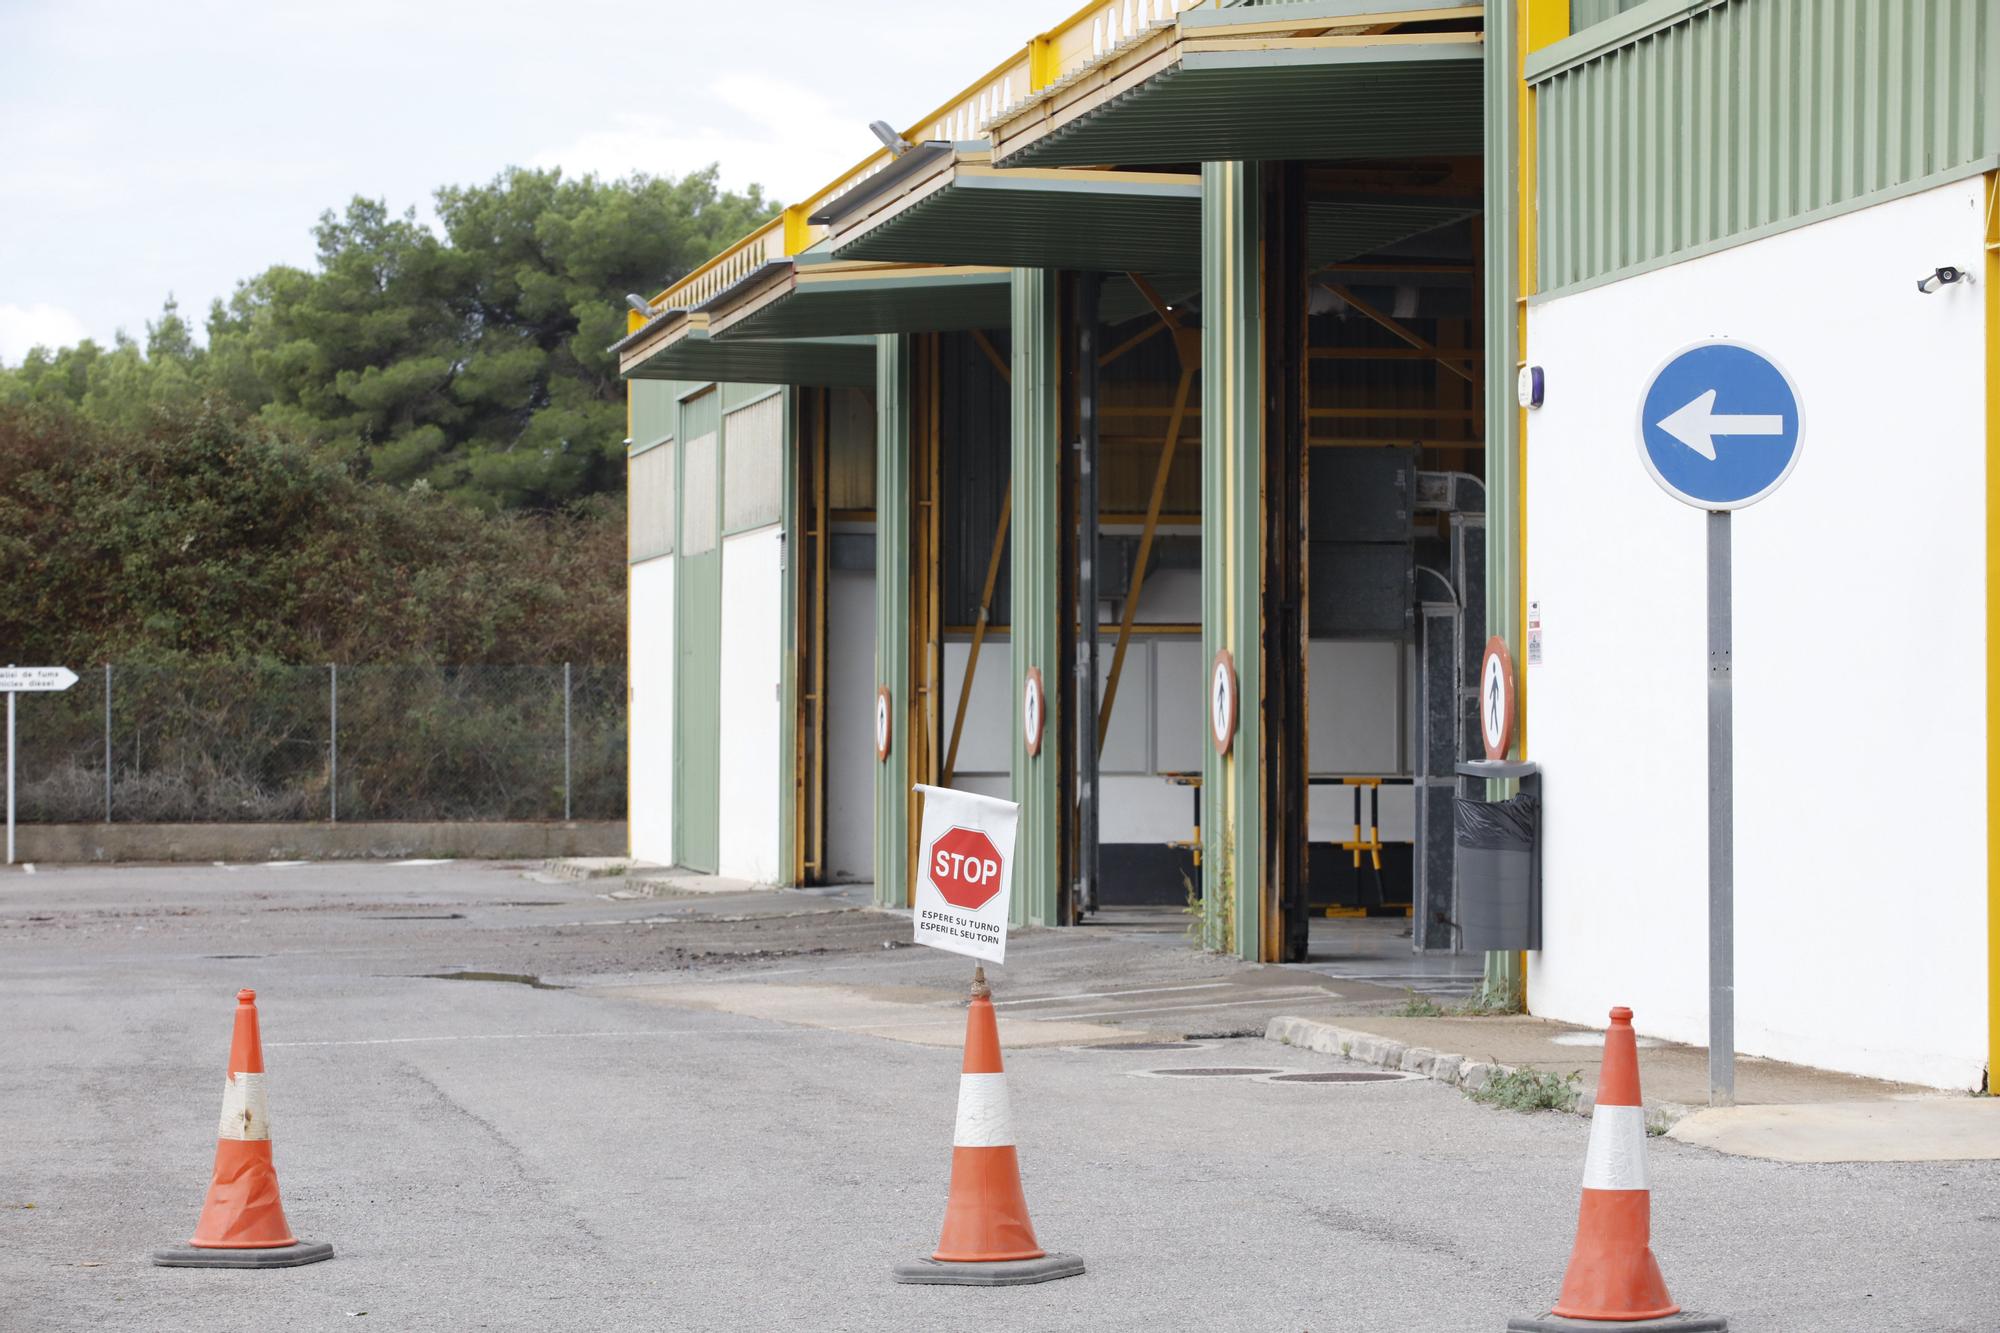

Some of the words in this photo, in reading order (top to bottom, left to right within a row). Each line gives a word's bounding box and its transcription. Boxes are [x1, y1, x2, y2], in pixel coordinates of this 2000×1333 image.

[935, 850, 998, 885] STOP
[921, 922, 948, 933] ESPERI
[950, 928, 958, 936] EL
[960, 929, 975, 940] SEU
[976, 933, 999, 945] TORN
[922, 911, 954, 923] ESPERE
[956, 918, 967, 927] SU
[969, 920, 1000, 933] TURNO
